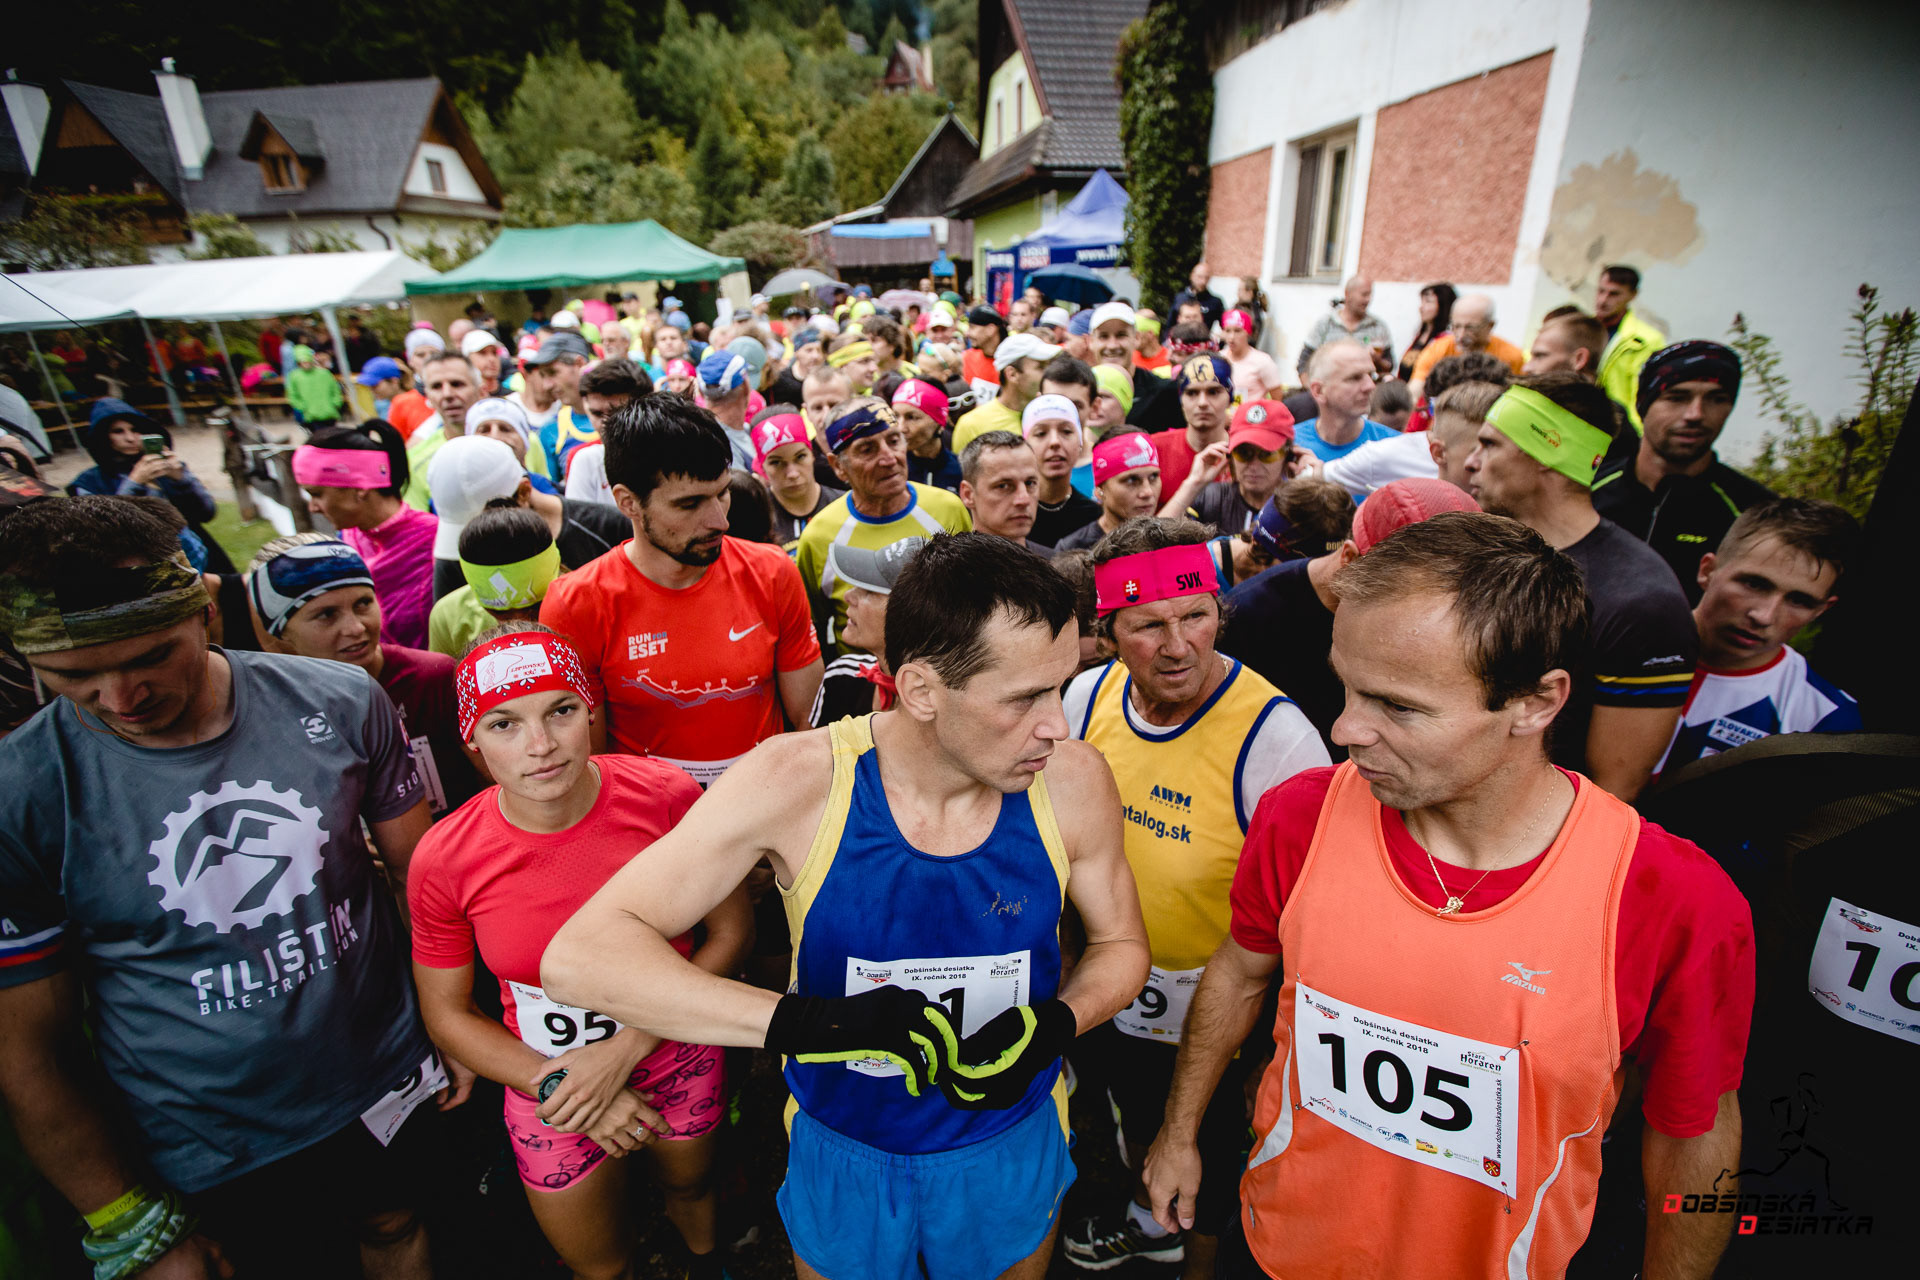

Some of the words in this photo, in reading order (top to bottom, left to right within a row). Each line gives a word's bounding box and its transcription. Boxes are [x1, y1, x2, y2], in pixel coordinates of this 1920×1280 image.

[1176, 571, 1203, 591] SVK
[628, 632, 651, 646] RUN
[652, 632, 667, 640] FOR
[628, 638, 668, 660] ESET
[904, 966, 942, 974] Dobšinská
[544, 1011, 618, 1047] 95
[1353, 1016, 1397, 1036] Dobšinská
[1399, 1031, 1439, 1048] desiatka
[1362, 1028, 1375, 1038] IX.
[1376, 1033, 1404, 1048] ročník
[1406, 1041, 1429, 1055] 2018
[1318, 1033, 1473, 1132] 105
